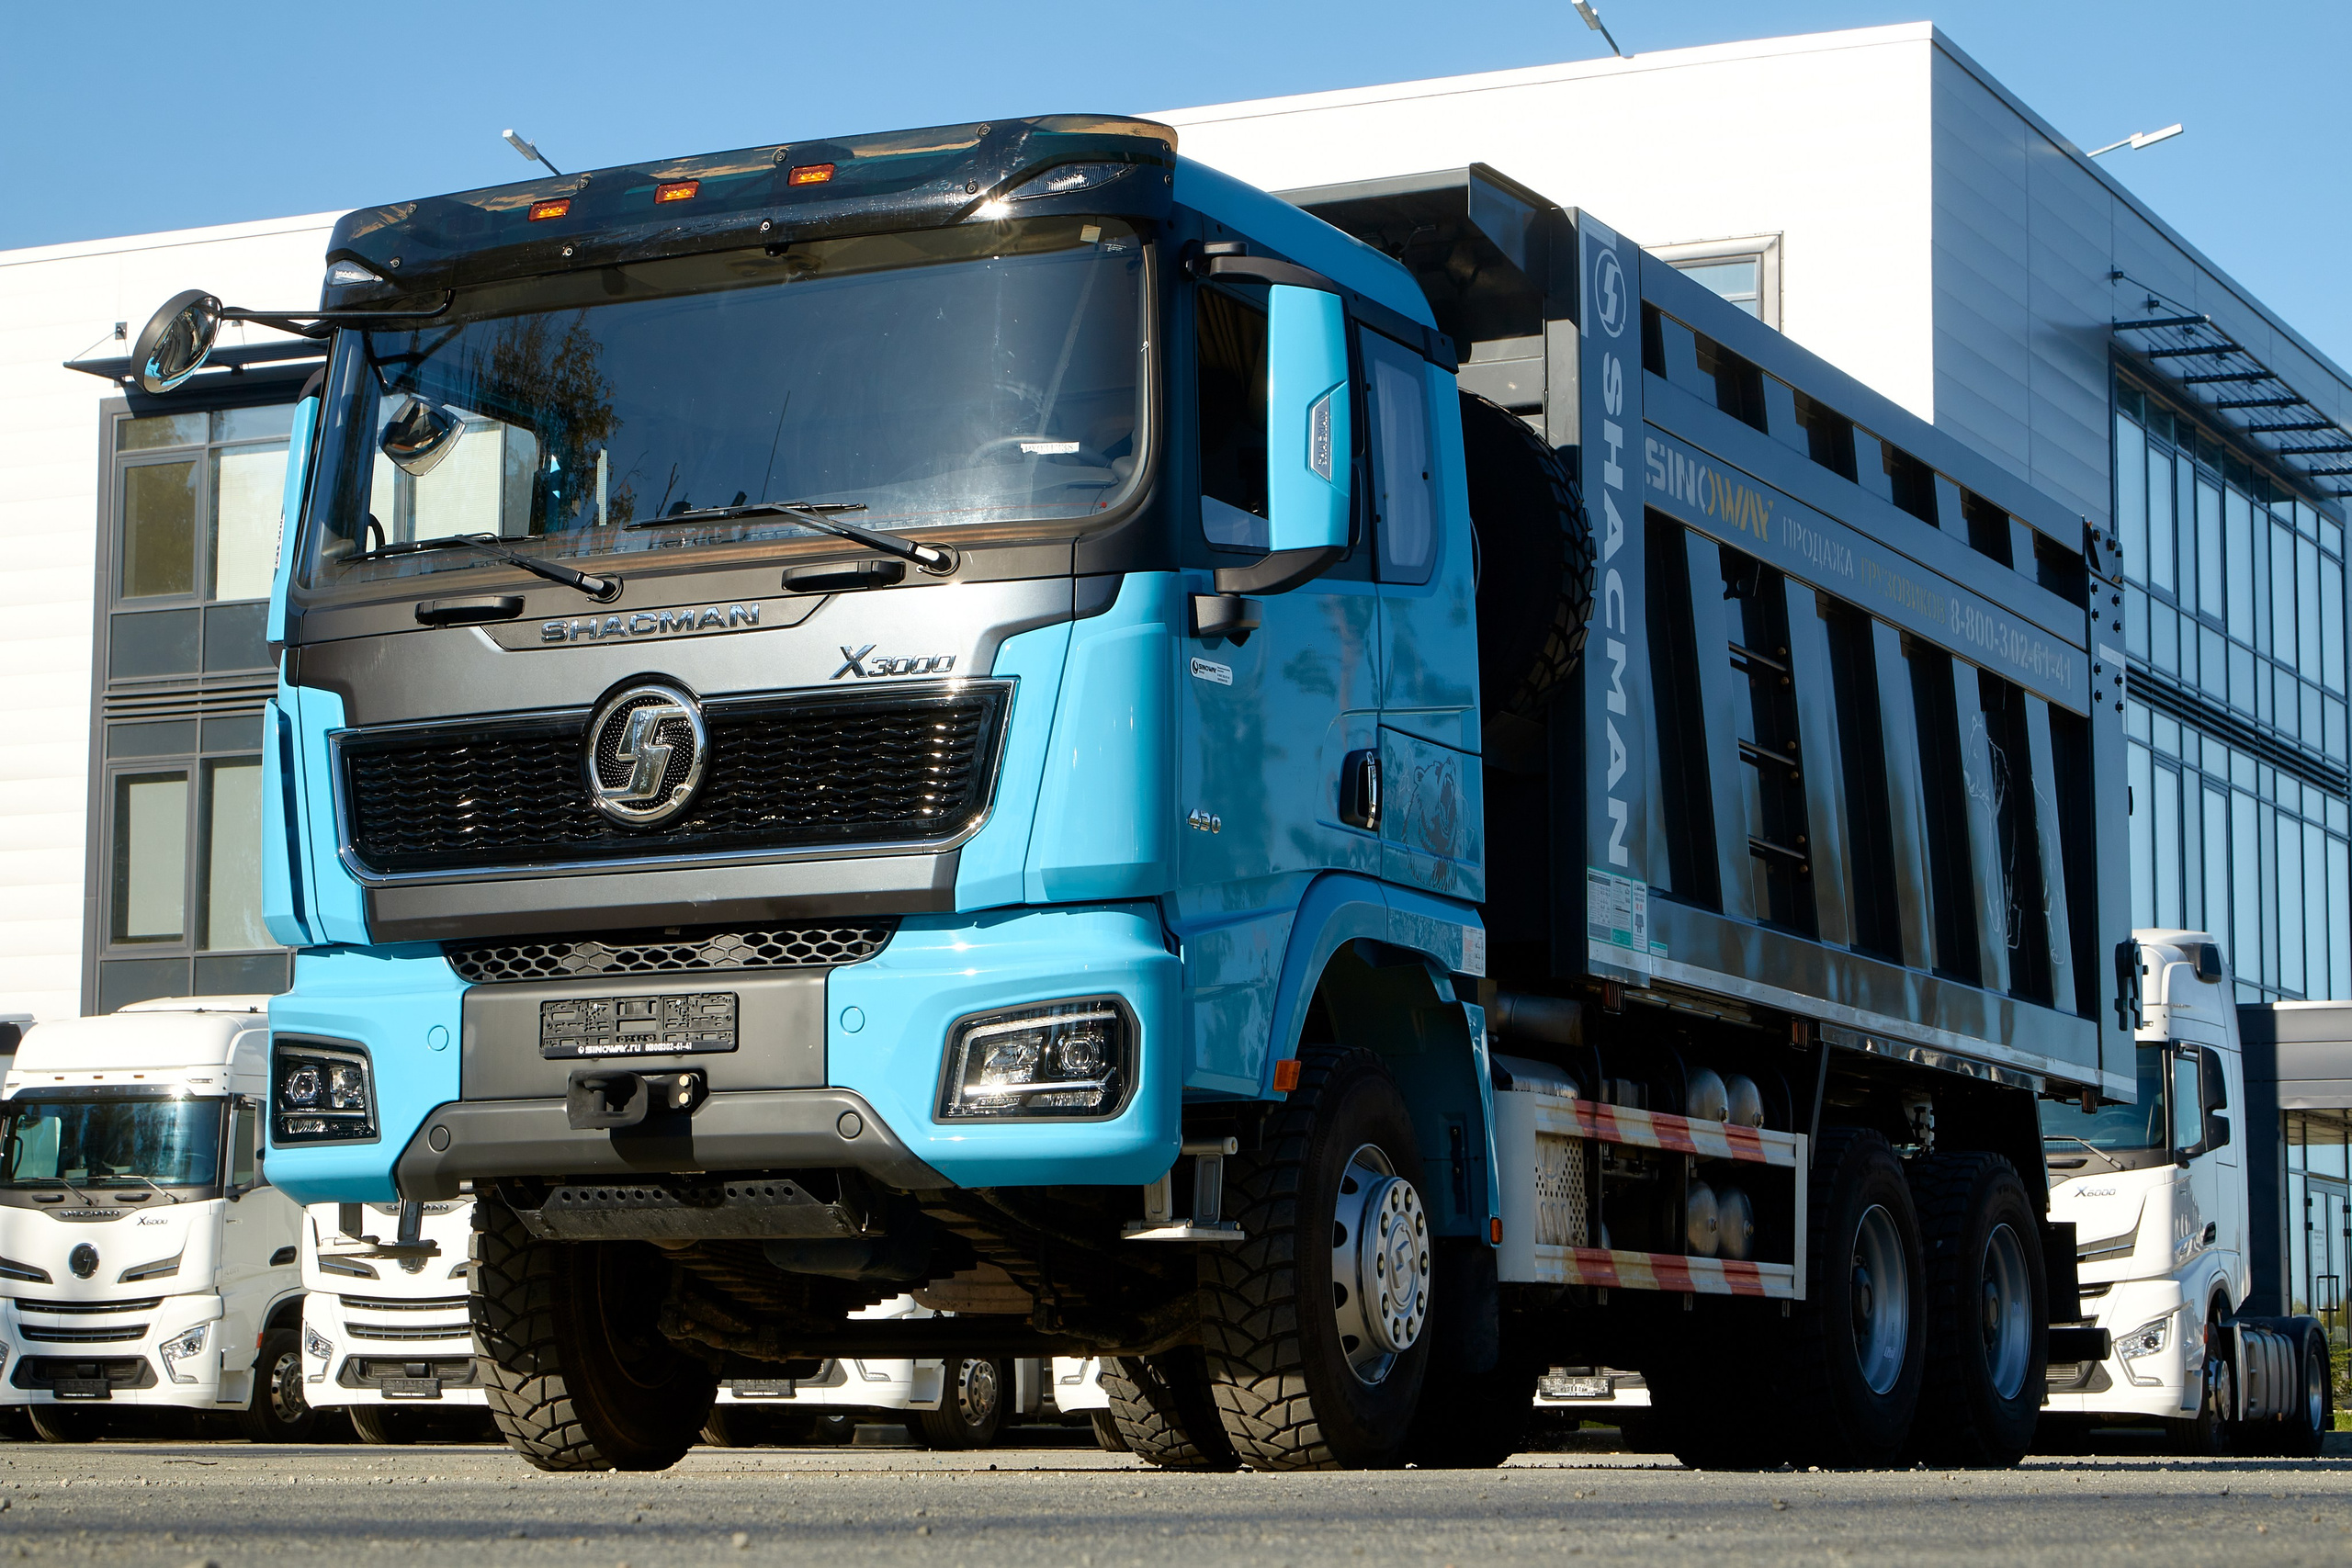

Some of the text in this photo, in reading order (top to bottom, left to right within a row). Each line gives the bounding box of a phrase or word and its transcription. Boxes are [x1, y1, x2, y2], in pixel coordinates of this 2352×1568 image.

[1317, 411, 1329, 466] SHACMAN
[1645, 437, 1774, 543] SINOWAY
[1782, 516, 1855, 580] ПРОДАЖА
[1860, 557, 1946, 625] ГРУЗОВИКОВ
[541, 603, 761, 644] SHACMAN
[1602, 351, 1628, 867] SHACMAN
[829, 644, 956, 680] X3000
[1185, 808, 1222, 834] 430
[980, 1098, 1021, 1106] SHACMAN
[386, 1203, 449, 1212] SHMAN
[2074, 1186, 2116, 1198] X6000
[59, 1210, 120, 1219] SHACMAN
